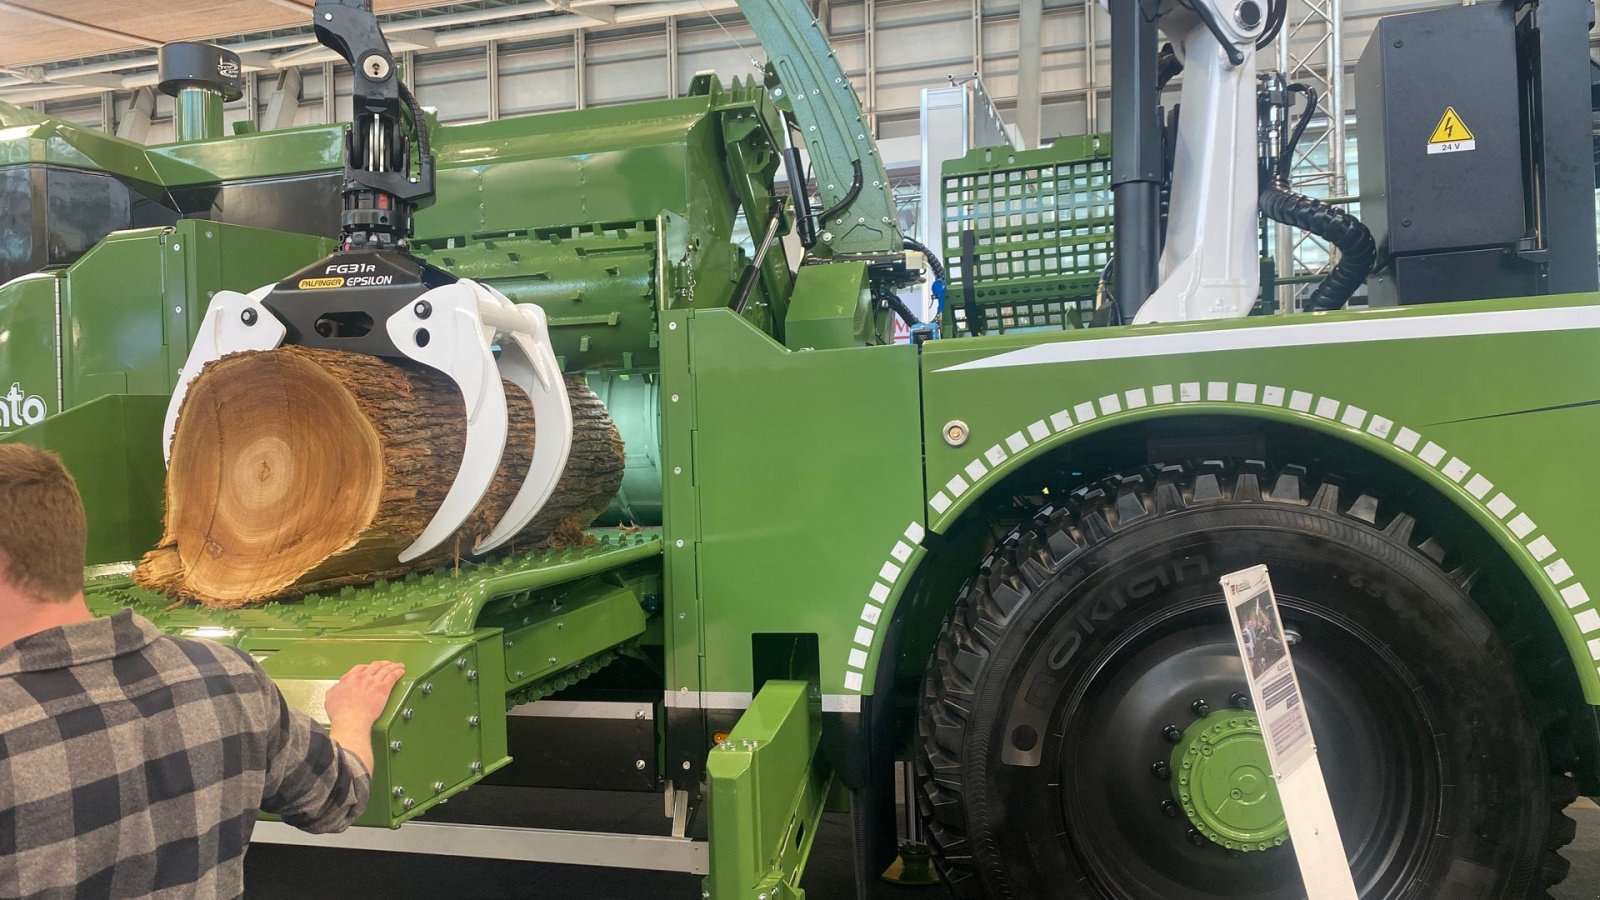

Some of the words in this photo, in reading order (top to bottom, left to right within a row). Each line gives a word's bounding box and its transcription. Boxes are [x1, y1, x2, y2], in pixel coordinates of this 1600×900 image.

[325, 263, 376, 274] FG31R
[301, 279, 342, 287] PALFINGER
[346, 275, 393, 287] EPSILON
